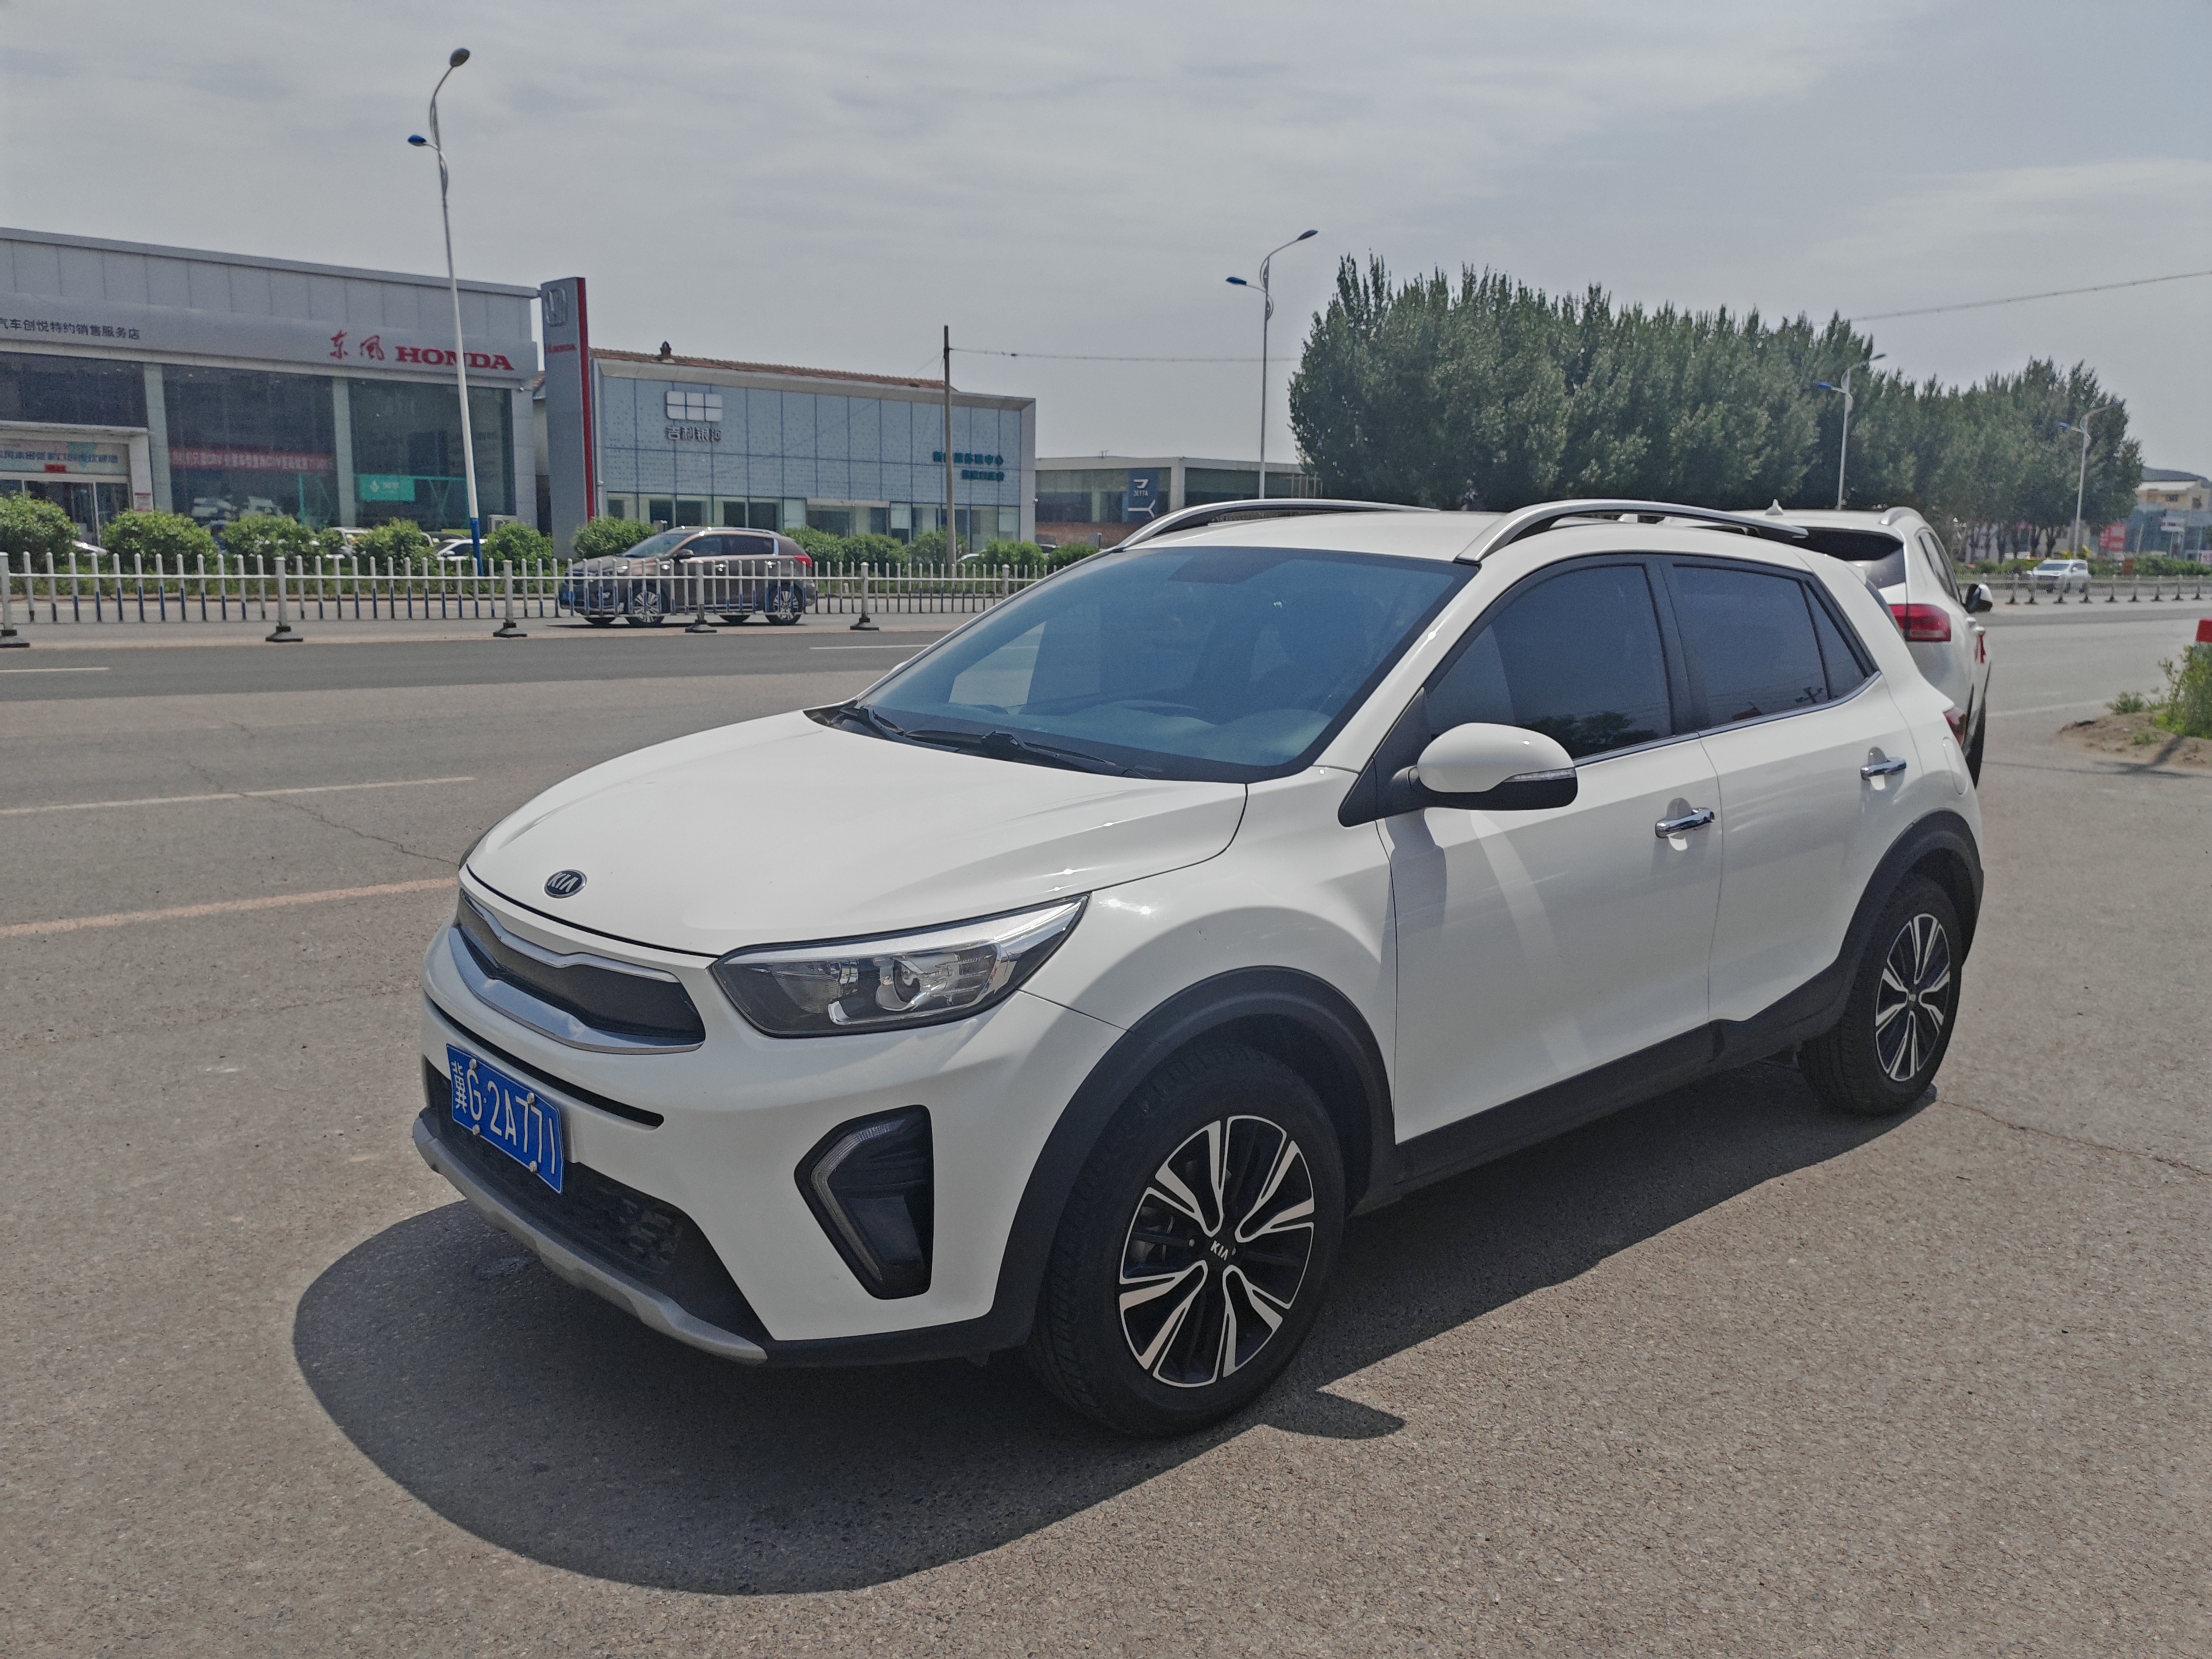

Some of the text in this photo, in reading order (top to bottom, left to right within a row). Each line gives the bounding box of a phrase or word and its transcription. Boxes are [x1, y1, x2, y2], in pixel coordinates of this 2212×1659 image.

[330, 330, 515, 371] 东风 HONDA
[666, 425, 721, 442] 吉利银河
[547, 872, 579, 893] KIA
[1210, 1240, 1229, 1262] KIA
